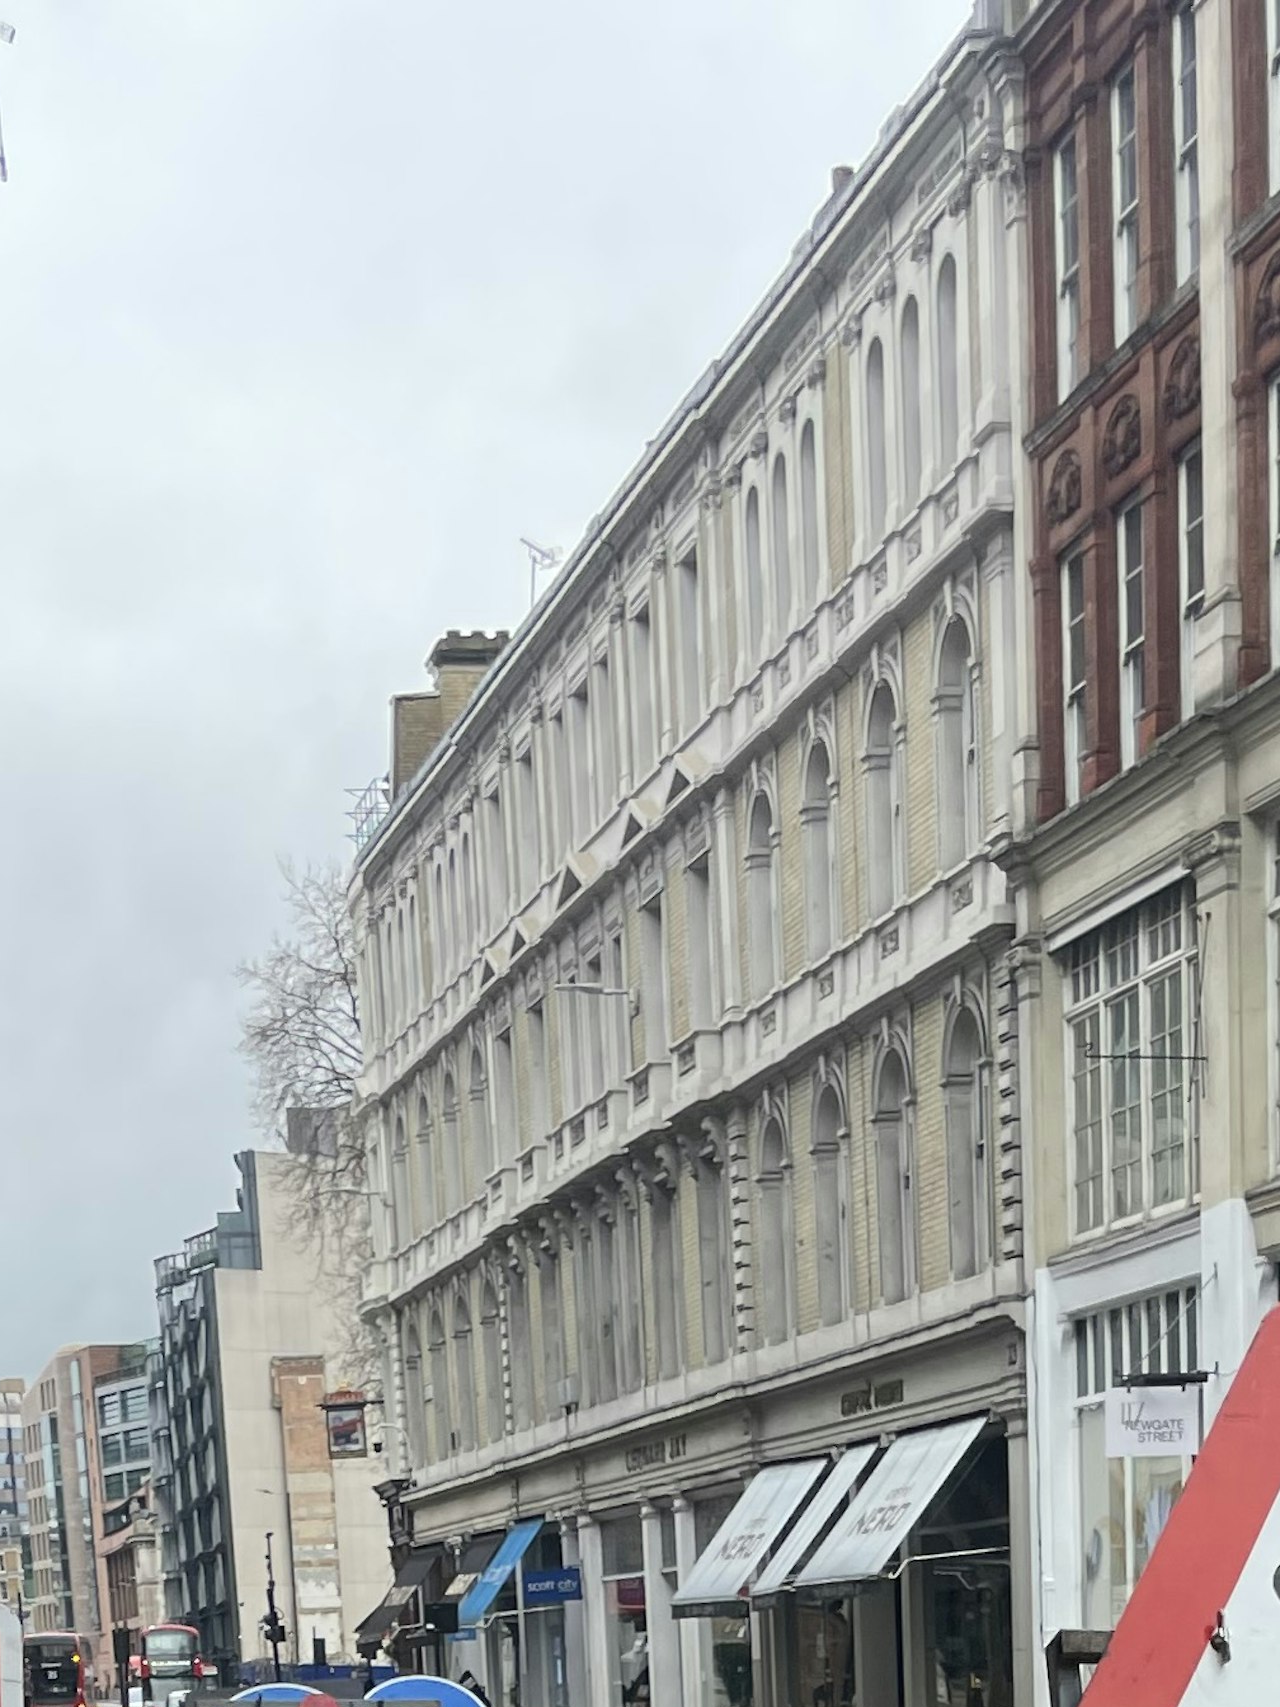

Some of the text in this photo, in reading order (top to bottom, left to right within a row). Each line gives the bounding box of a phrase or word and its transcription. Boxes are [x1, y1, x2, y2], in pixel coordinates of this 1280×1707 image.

[1124, 1418, 1185, 1432] NEWGATE
[1138, 1431, 1185, 1443] STREET
[847, 1502, 912, 1536] NERO
